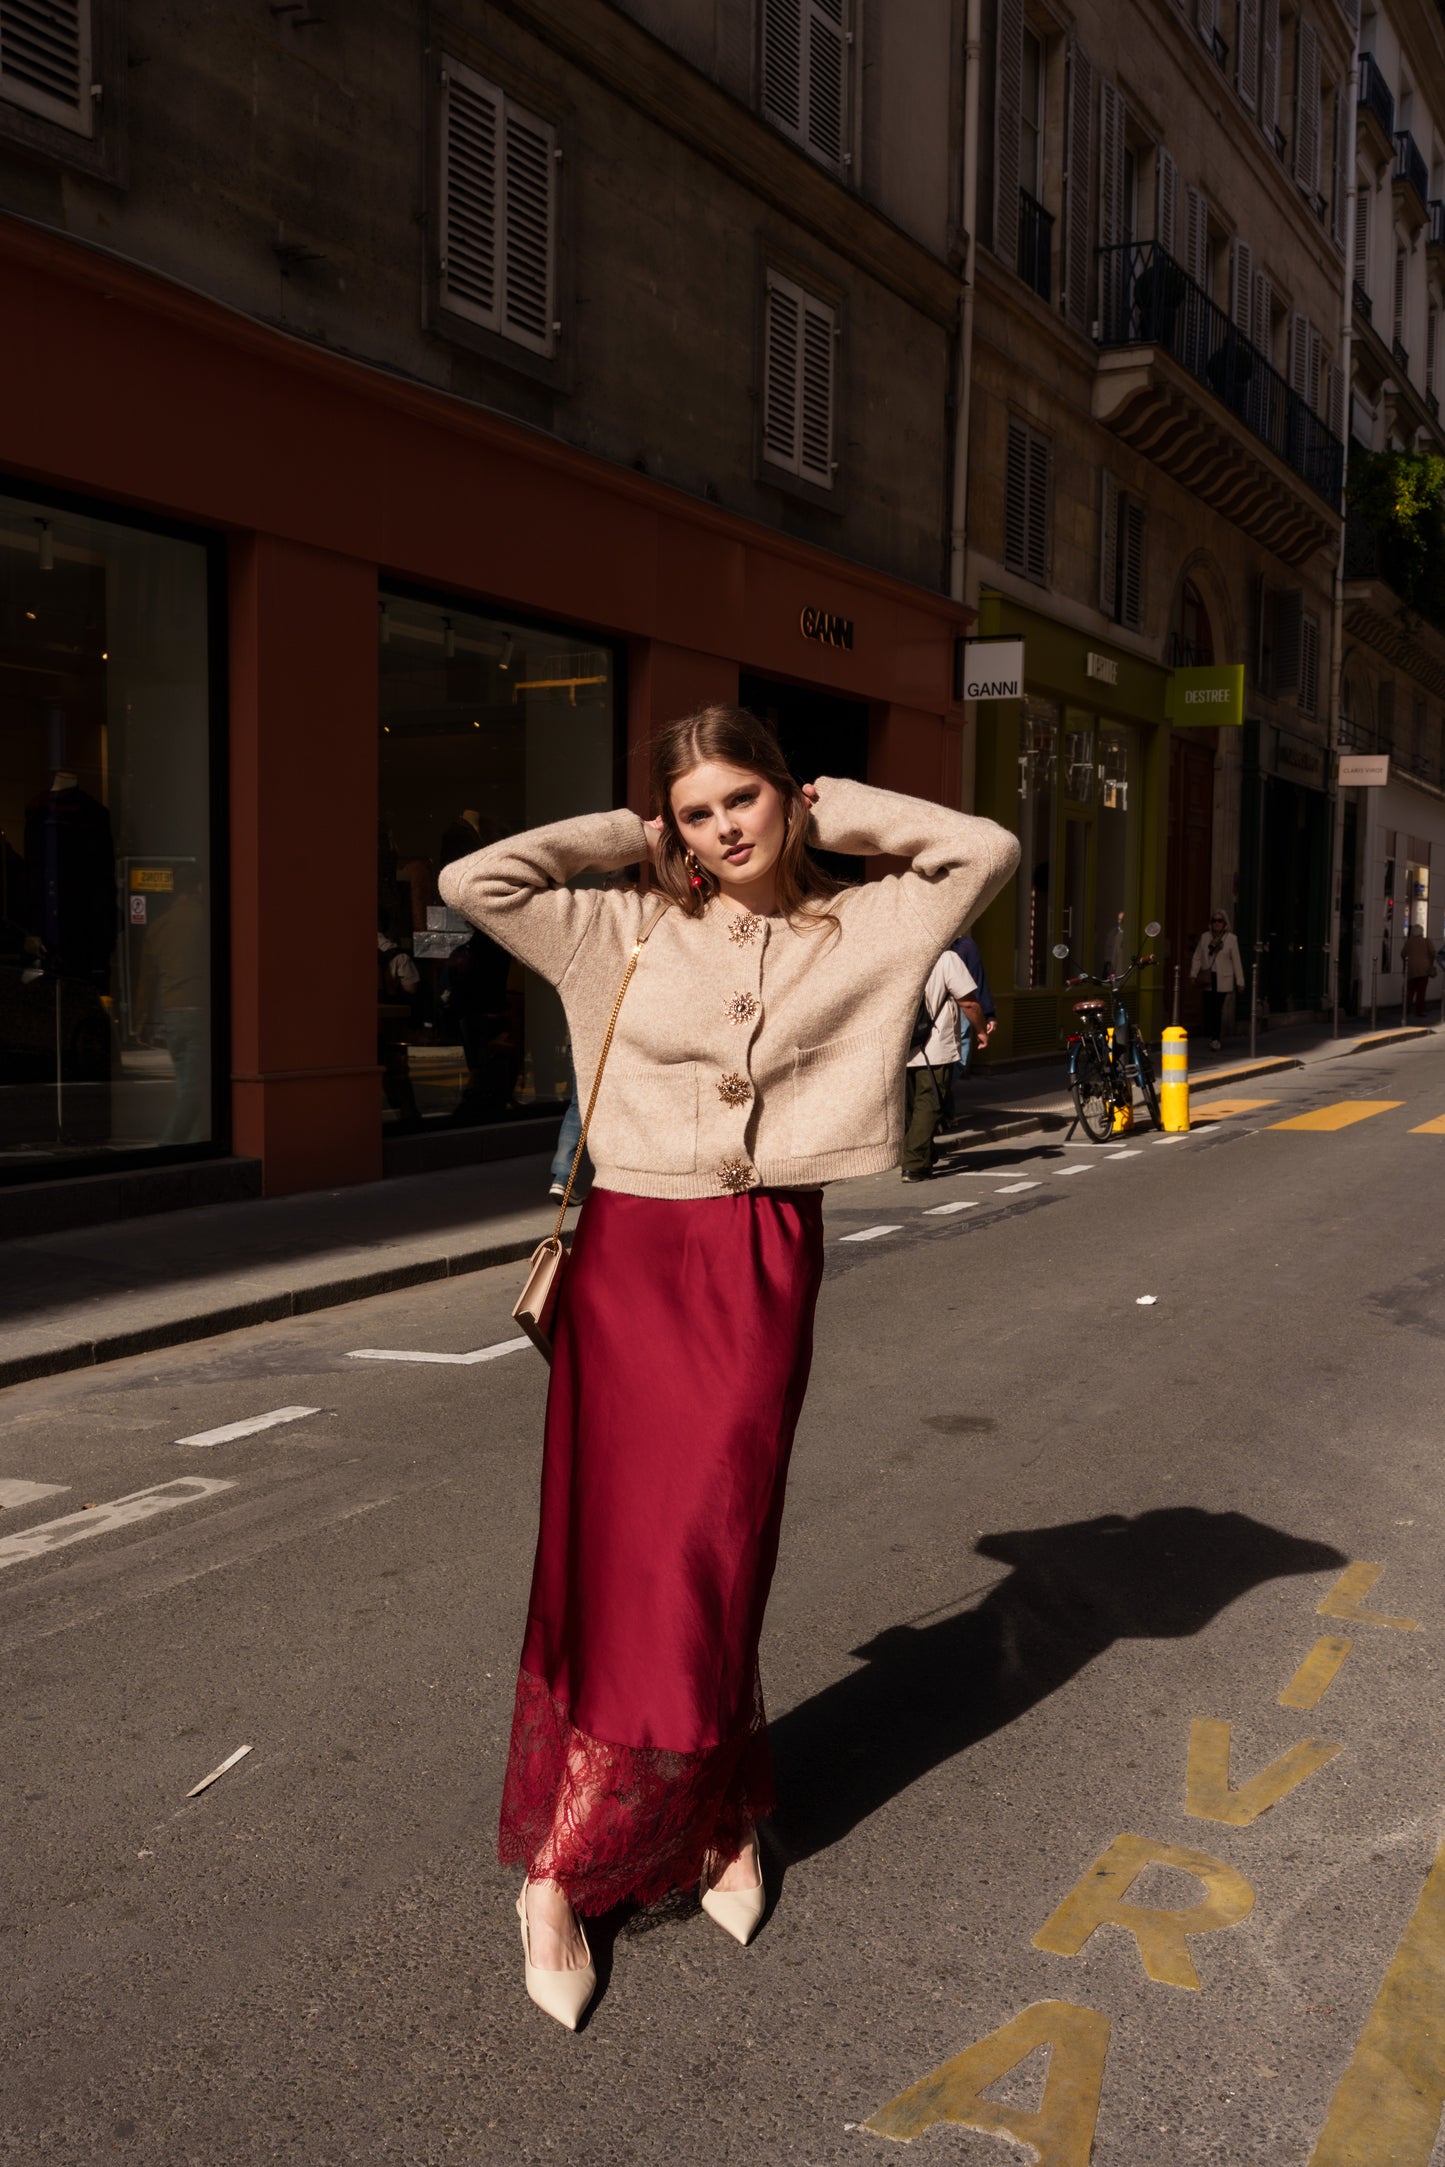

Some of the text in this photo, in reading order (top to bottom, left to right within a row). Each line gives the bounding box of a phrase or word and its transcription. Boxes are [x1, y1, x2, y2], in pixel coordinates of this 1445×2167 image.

[800, 606, 854, 651] GANNI
[967, 681, 1018, 697] GANNI
[1184, 688, 1231, 704] DESTREE
